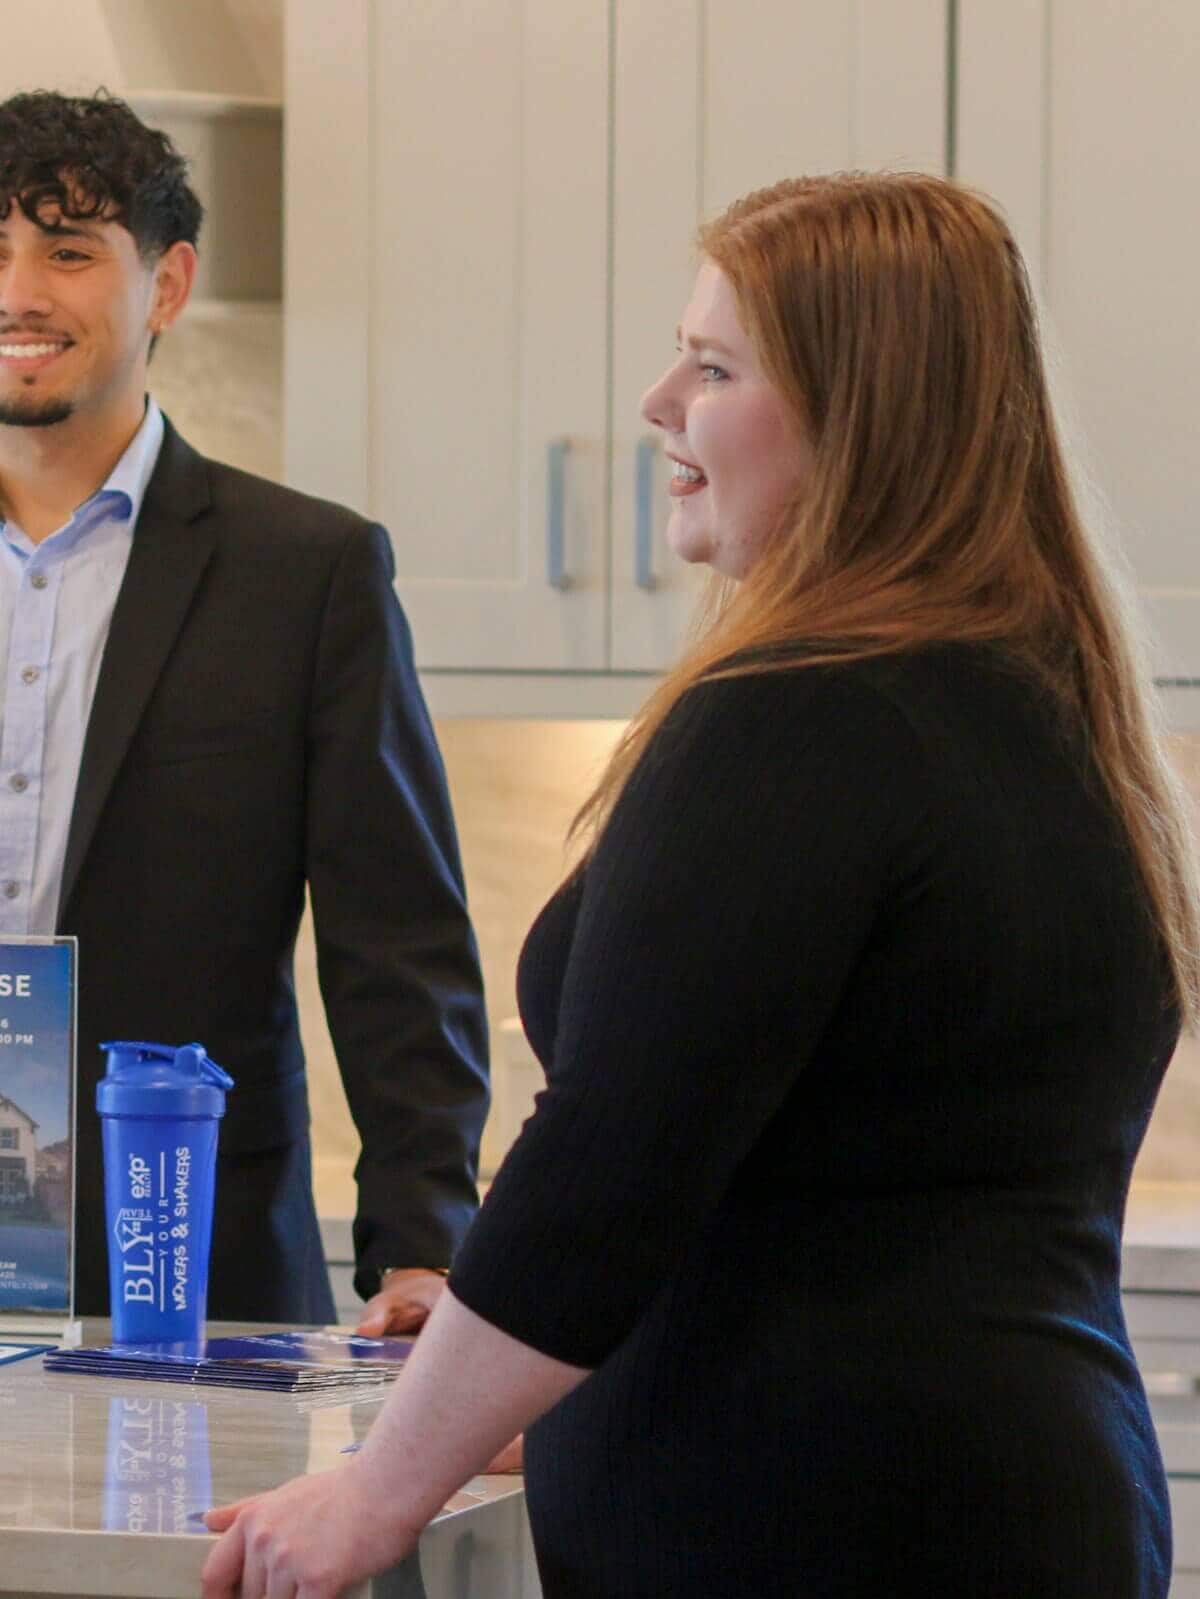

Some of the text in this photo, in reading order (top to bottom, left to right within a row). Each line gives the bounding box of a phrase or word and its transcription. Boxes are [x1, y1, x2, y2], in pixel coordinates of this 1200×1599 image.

[15, 1035, 34, 1045] PM
[158, 1199, 169, 1256] YOUR
[171, 1146, 192, 1311] MOVERS & SHAKERS
[123, 1223, 155, 1304] BLY
